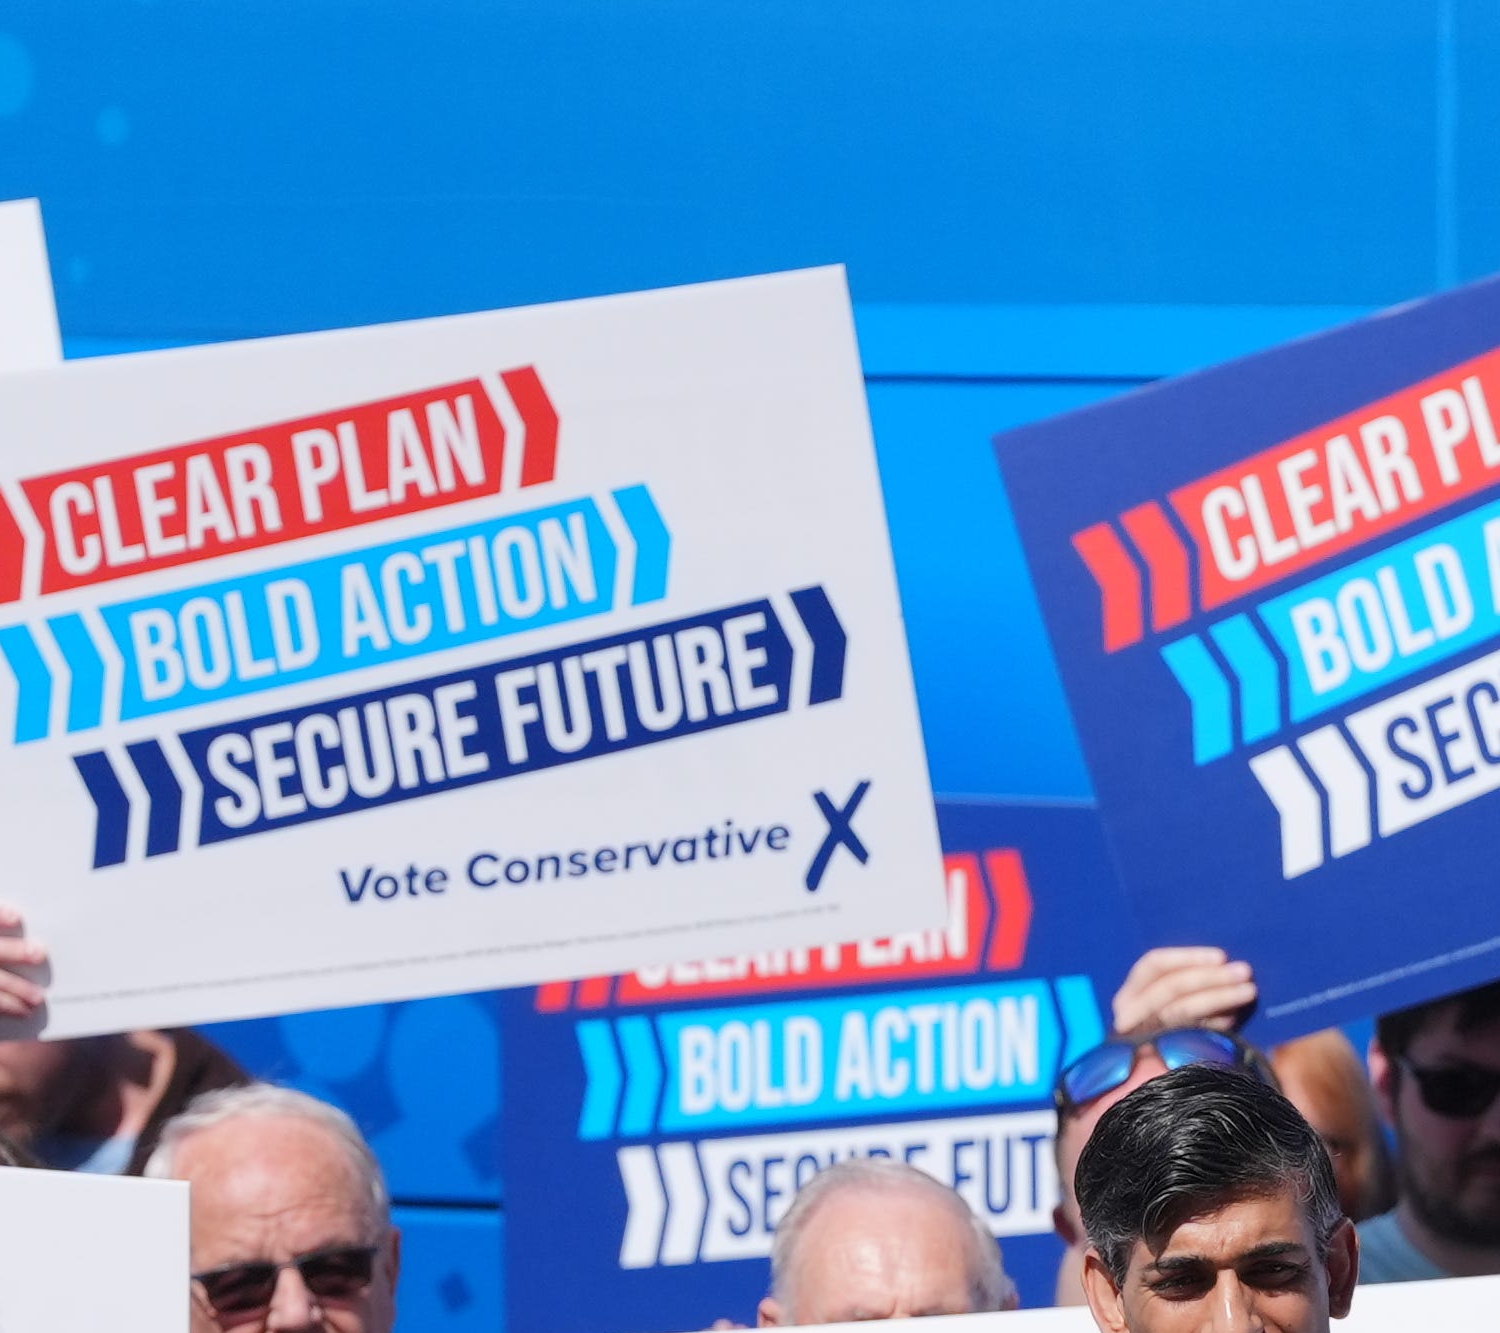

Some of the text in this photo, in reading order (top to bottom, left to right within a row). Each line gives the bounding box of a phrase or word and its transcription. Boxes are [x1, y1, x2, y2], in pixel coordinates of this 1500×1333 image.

[48, 394, 487, 576] CLEAR PLAN
[1200, 416, 1421, 582] CLEAR
[128, 511, 596, 703] BOLD ACTION
[1289, 542, 1474, 696] BOLD
[204, 611, 781, 829] SECURE FUTURE
[338, 819, 791, 905] Vote Conservative
[678, 995, 1038, 1115] BOLD ACTION
[953, 1135, 1046, 1214] FUT
